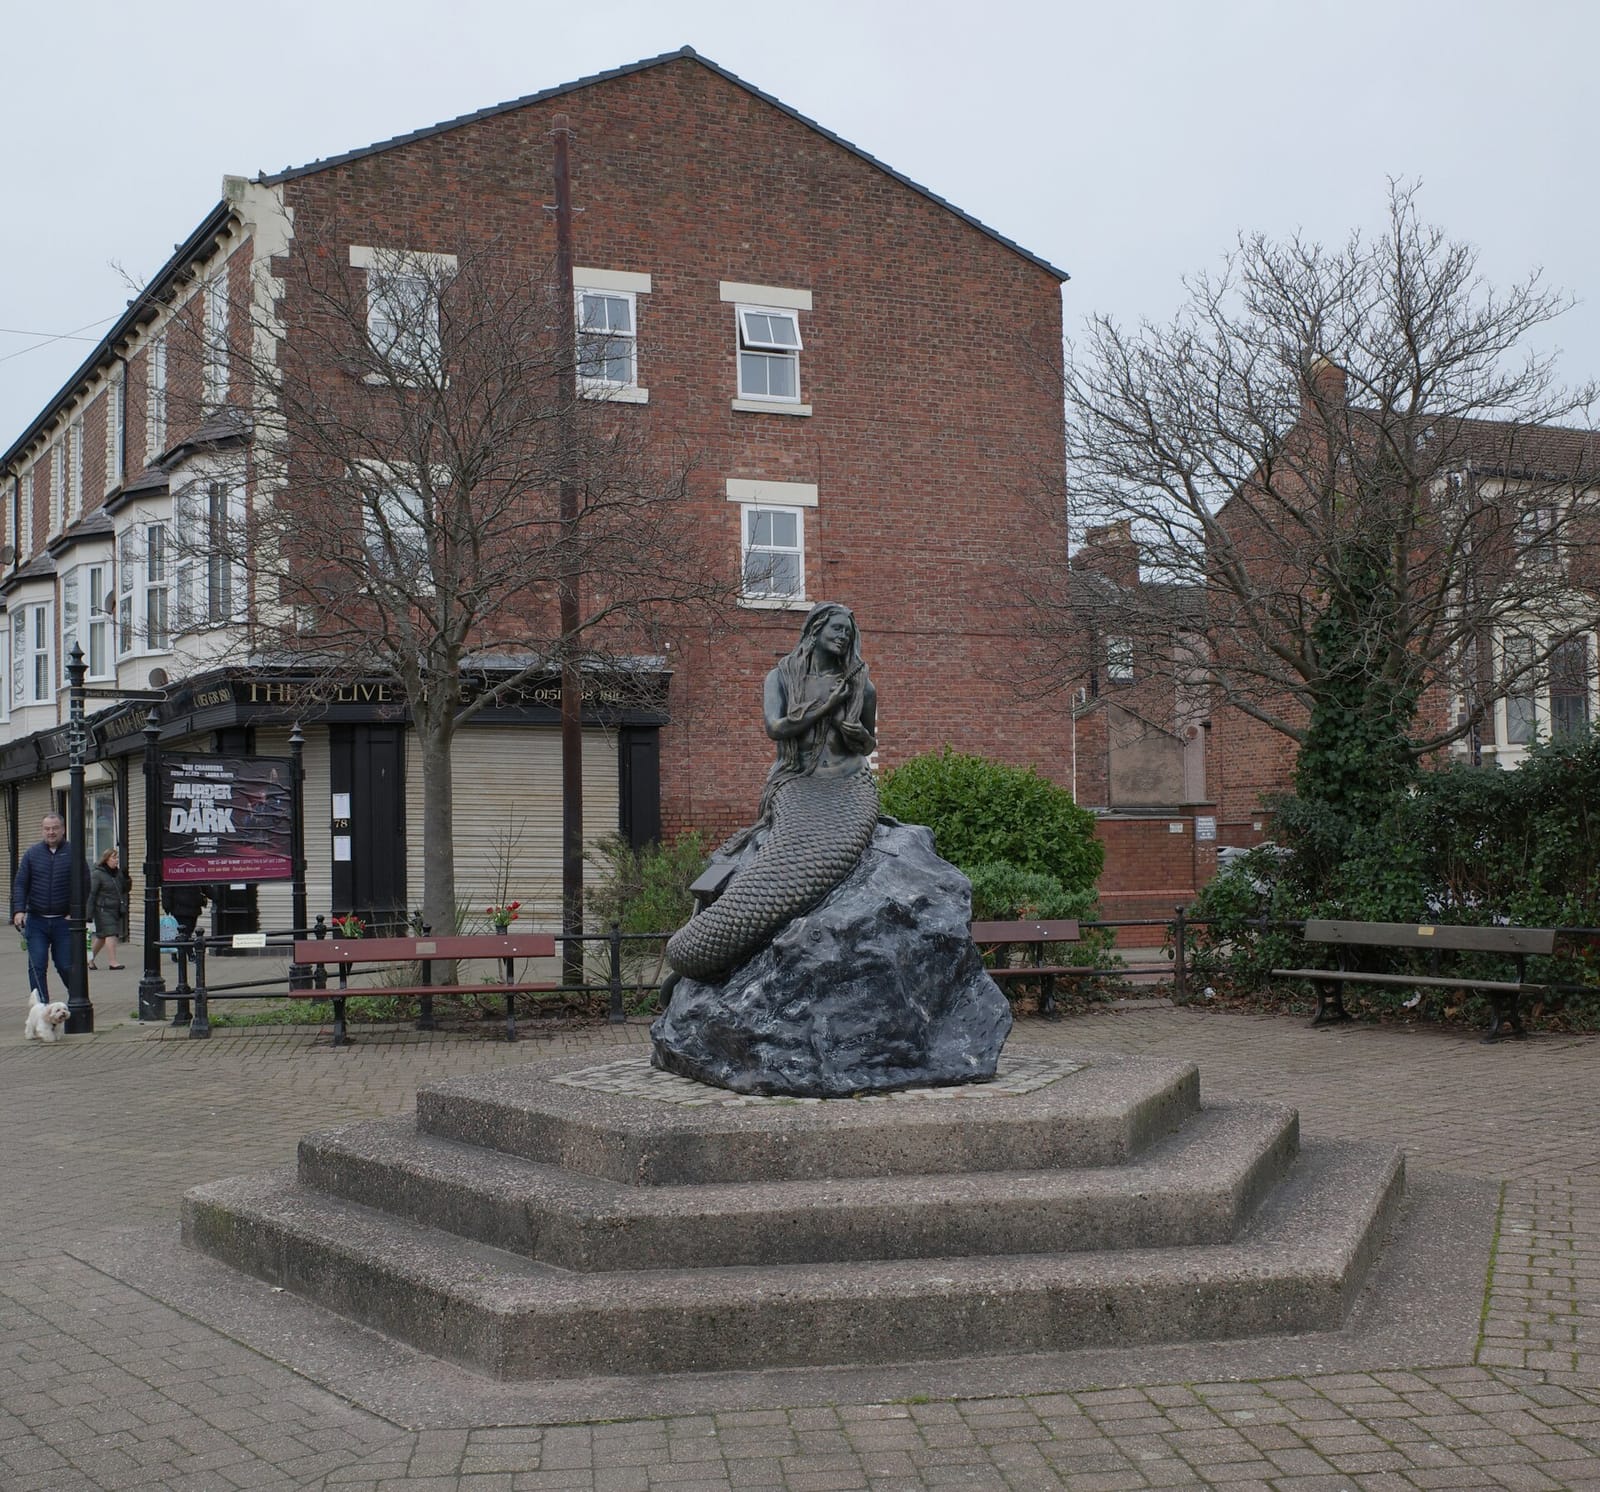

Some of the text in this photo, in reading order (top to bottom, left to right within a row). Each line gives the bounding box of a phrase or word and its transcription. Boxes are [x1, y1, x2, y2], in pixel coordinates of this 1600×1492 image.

[535, 689, 561, 702] 0151
[172, 783, 233, 800] MURDER
[199, 799, 215, 809] THE
[169, 807, 237, 833] DARK
[334, 820, 348, 828] 78
